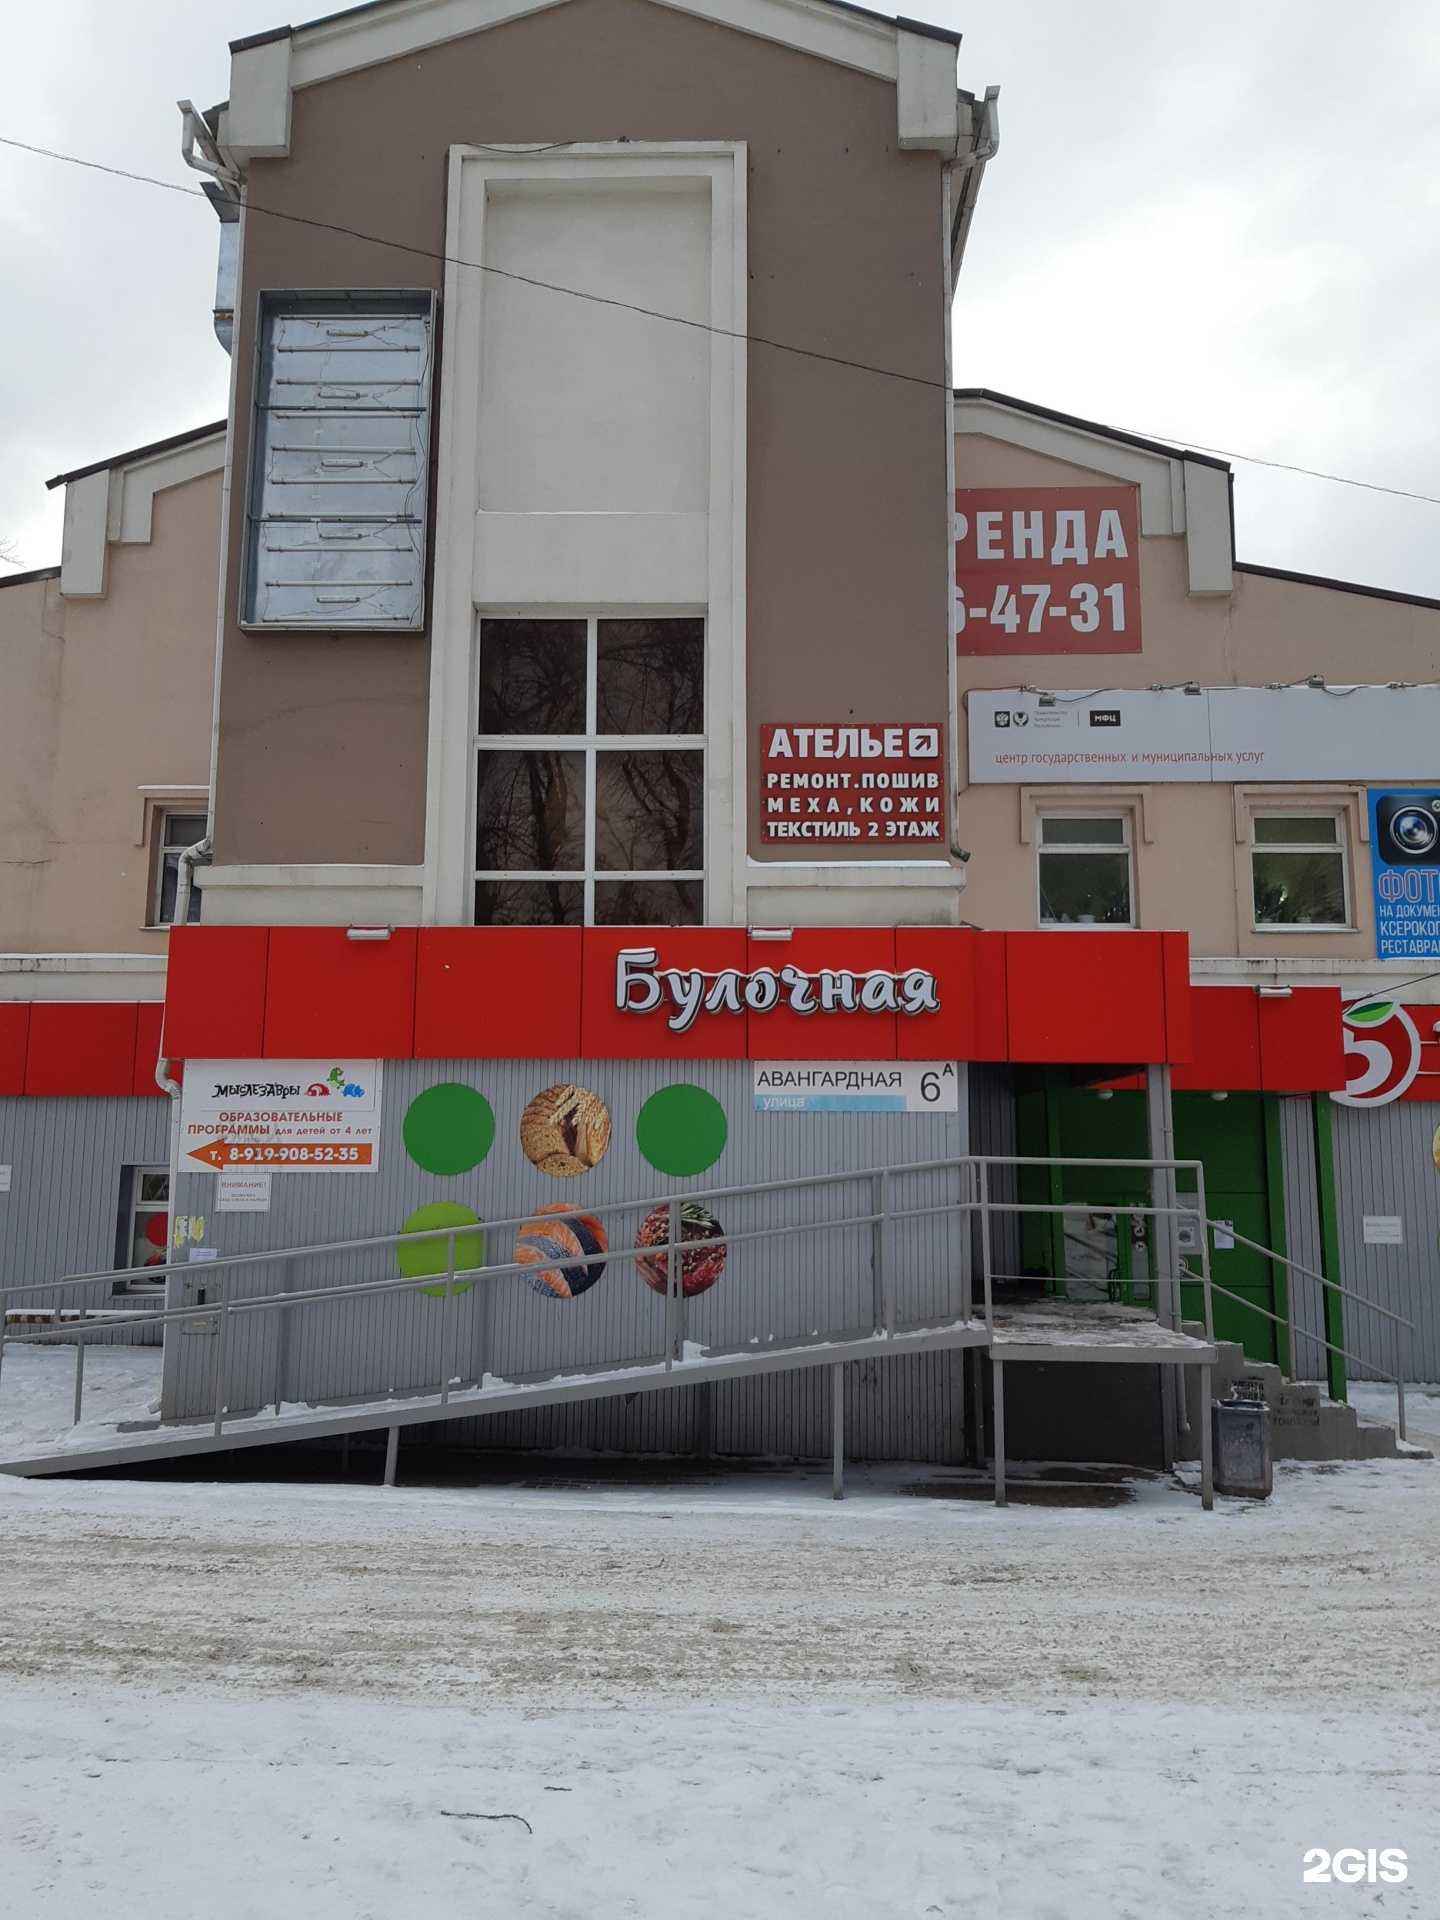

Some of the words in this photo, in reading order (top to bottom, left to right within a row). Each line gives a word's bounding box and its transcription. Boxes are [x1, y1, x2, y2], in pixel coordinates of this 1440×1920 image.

[768, 728, 904, 759] АТЕЛЬЕ
[995, 753, 1029, 766] центр
[1031, 752, 1127, 767] государственных
[1131, 752, 1138, 761] и
[1142, 752, 1233, 766] муниципальных
[1236, 752, 1265, 765] услуг
[767, 822, 860, 837] ТЕКСТИЛЬ
[868, 822, 879, 837] 2
[885, 821, 940, 837] ЭТАЖ
[1378, 868, 1440, 904] ФОТ
[1379, 904, 1394, 918] НА
[616, 947, 941, 1033] Булочная
[757, 1071, 902, 1090] АВАНГАРДНАЯ
[764, 1096, 805, 1110] улица
[219, 1112, 343, 1122] ОБРАЗОВАТЕЛЬНЫЕ
[187, 1125, 270, 1135] ПРОГРАММЫ
[297, 1127, 325, 1135] детей
[345, 1126, 351, 1135] 4
[355, 1127, 372, 1135] лет
[209, 1151, 222, 1161] т.
[229, 1148, 359, 1161] 8-919-908-52-35
